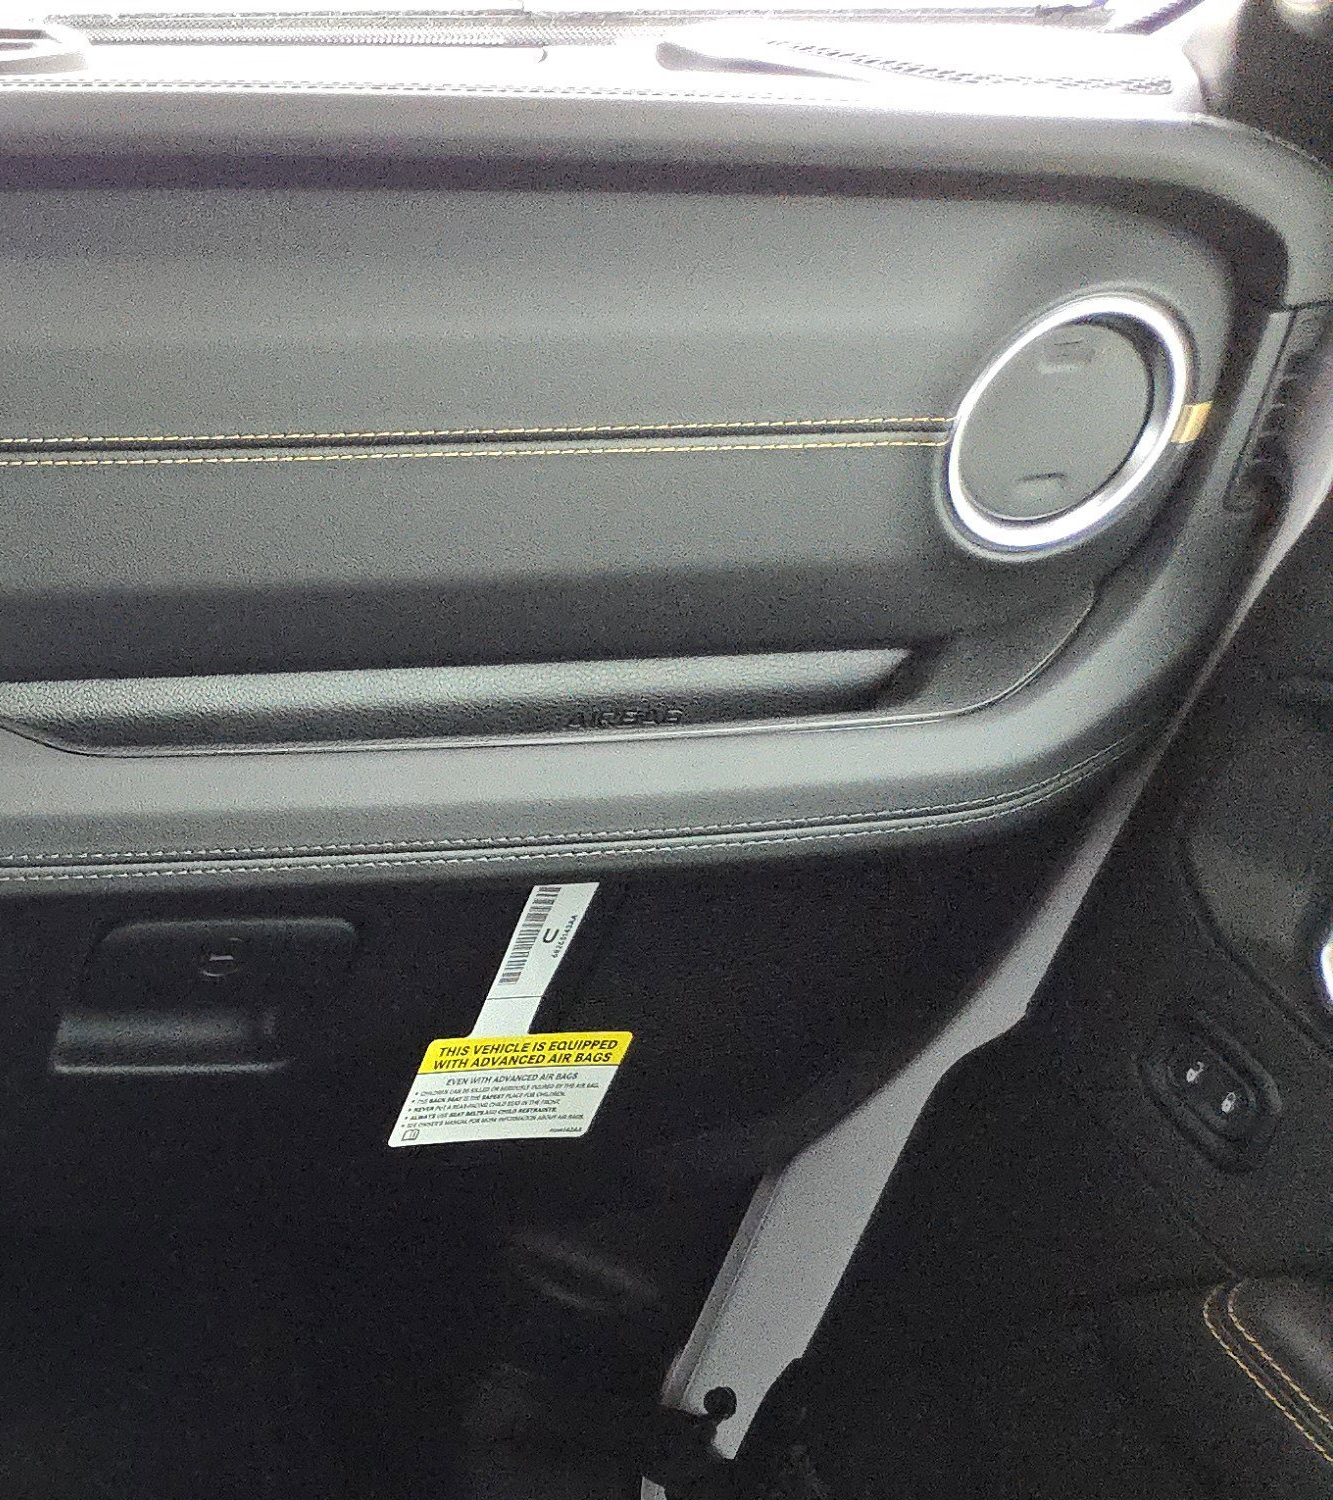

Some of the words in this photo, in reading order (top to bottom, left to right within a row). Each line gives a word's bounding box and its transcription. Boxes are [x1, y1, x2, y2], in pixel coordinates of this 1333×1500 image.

[543, 928, 559, 943] U
[440, 1047, 468, 1058] THIS
[473, 1043, 532, 1055] VEHICLE
[532, 1041, 545, 1052] IS
[549, 1040, 618, 1052] EQUIPPED
[434, 1059, 468, 1070] WITH
[471, 1055, 546, 1068] ADVANCED
[548, 1053, 571, 1064] AIR
[575, 1052, 613, 1063] BAGS
[446, 1078, 469, 1086] EVEN
[470, 1076, 492, 1084] WITH
[493, 1074, 538, 1083] ADVANCED
[539, 1073, 554, 1081] AIR
[555, 1072, 578, 1080] BAGS
